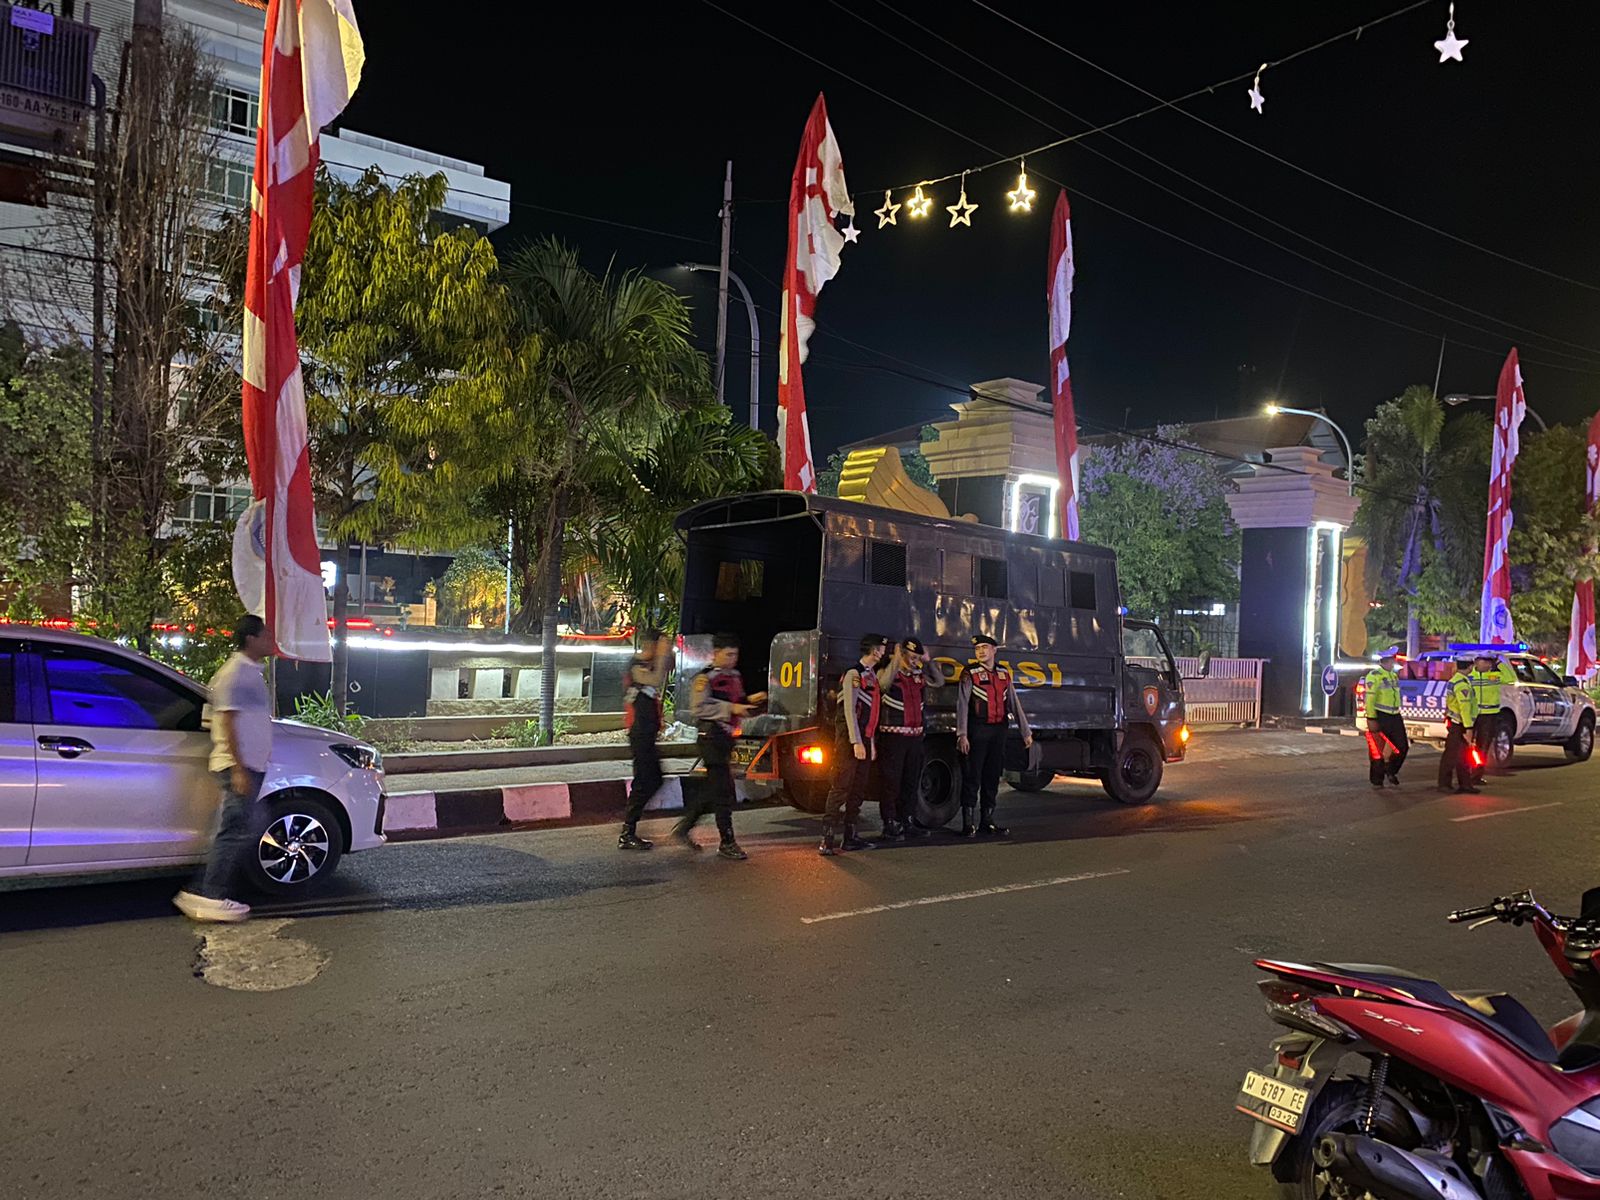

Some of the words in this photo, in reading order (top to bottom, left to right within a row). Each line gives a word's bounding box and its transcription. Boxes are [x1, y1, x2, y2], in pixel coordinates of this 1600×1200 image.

[780, 661, 803, 689] 01
[1246, 1076, 1256, 1090] W
[1260, 1081, 1286, 1103] 6787
[1289, 1092, 1305, 1111] FE
